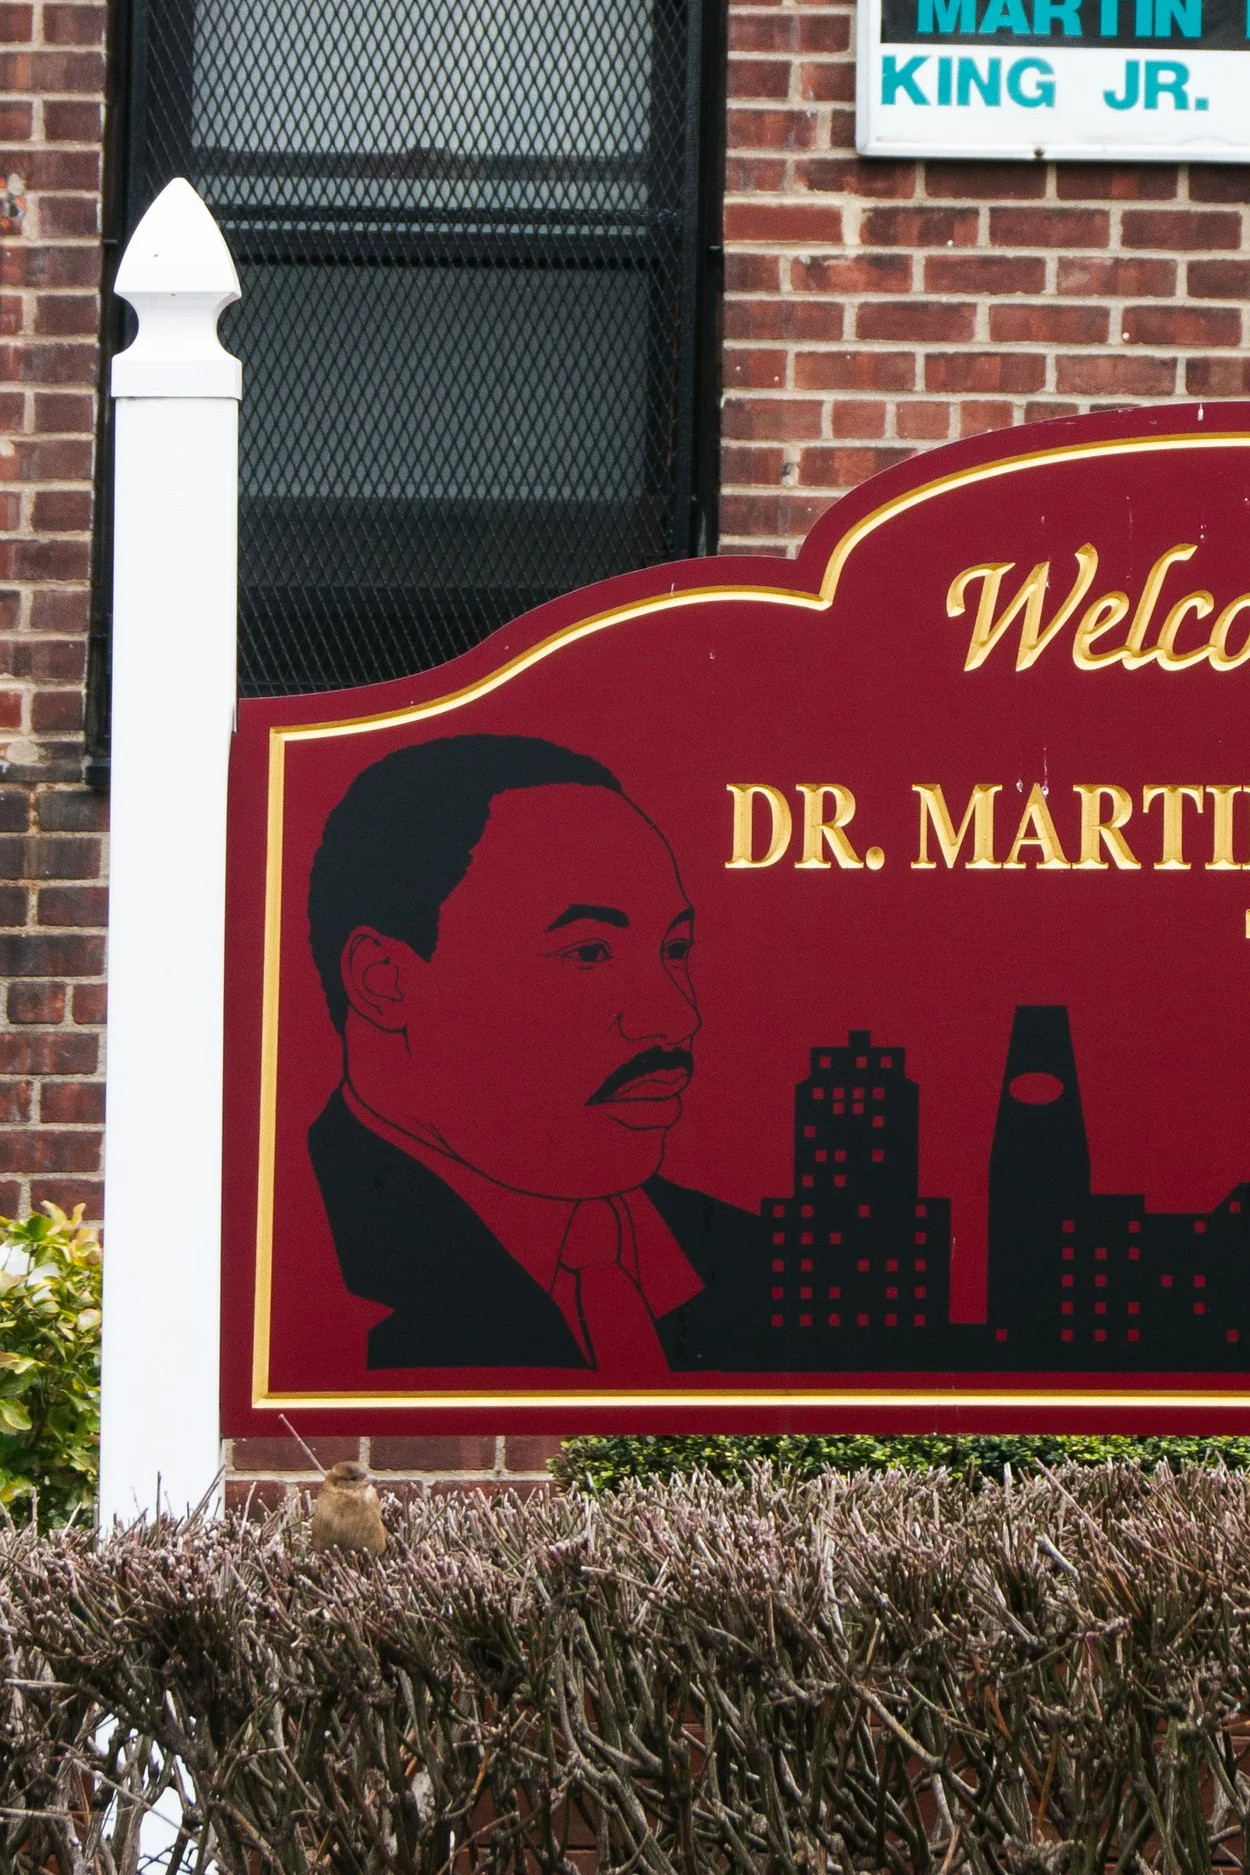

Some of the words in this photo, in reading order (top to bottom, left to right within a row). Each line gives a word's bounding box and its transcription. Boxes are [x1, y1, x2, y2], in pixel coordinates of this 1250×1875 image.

[880, 55, 1057, 109] KING
[1103, 60, 1209, 111] JR.
[724, 783, 885, 871] DR.
